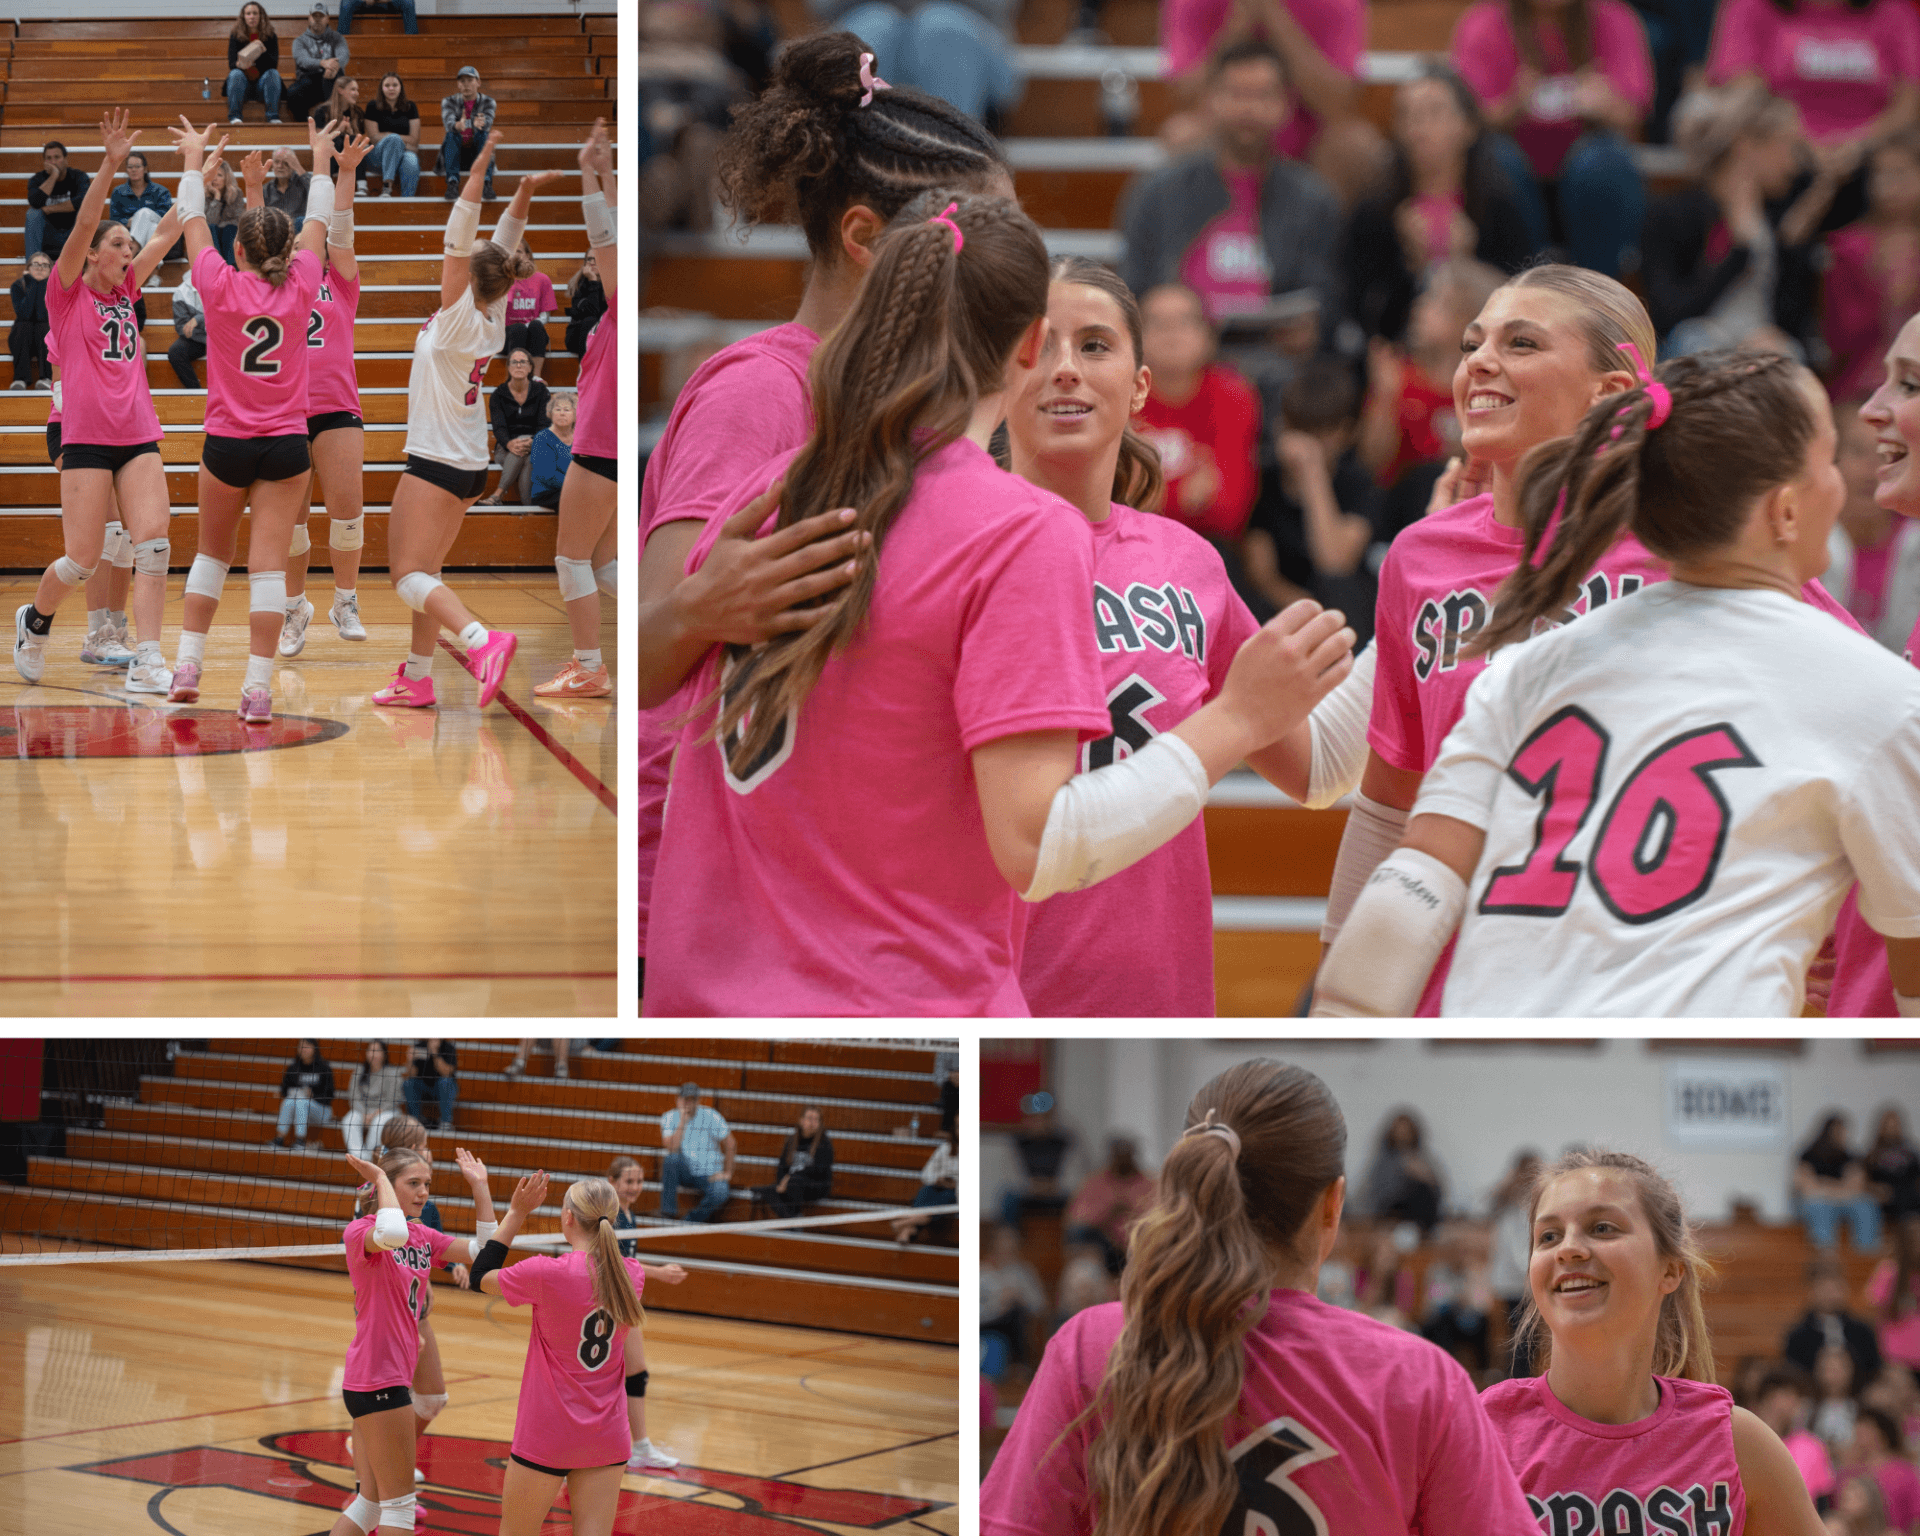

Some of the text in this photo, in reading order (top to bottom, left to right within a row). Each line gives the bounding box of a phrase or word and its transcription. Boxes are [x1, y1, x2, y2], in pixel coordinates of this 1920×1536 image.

[99, 318, 137, 362] 13
[240, 314, 284, 377] 2
[1093, 580, 1206, 667] ASH
[1479, 705, 1764, 926] 16
[576, 1305, 617, 1373] 8
